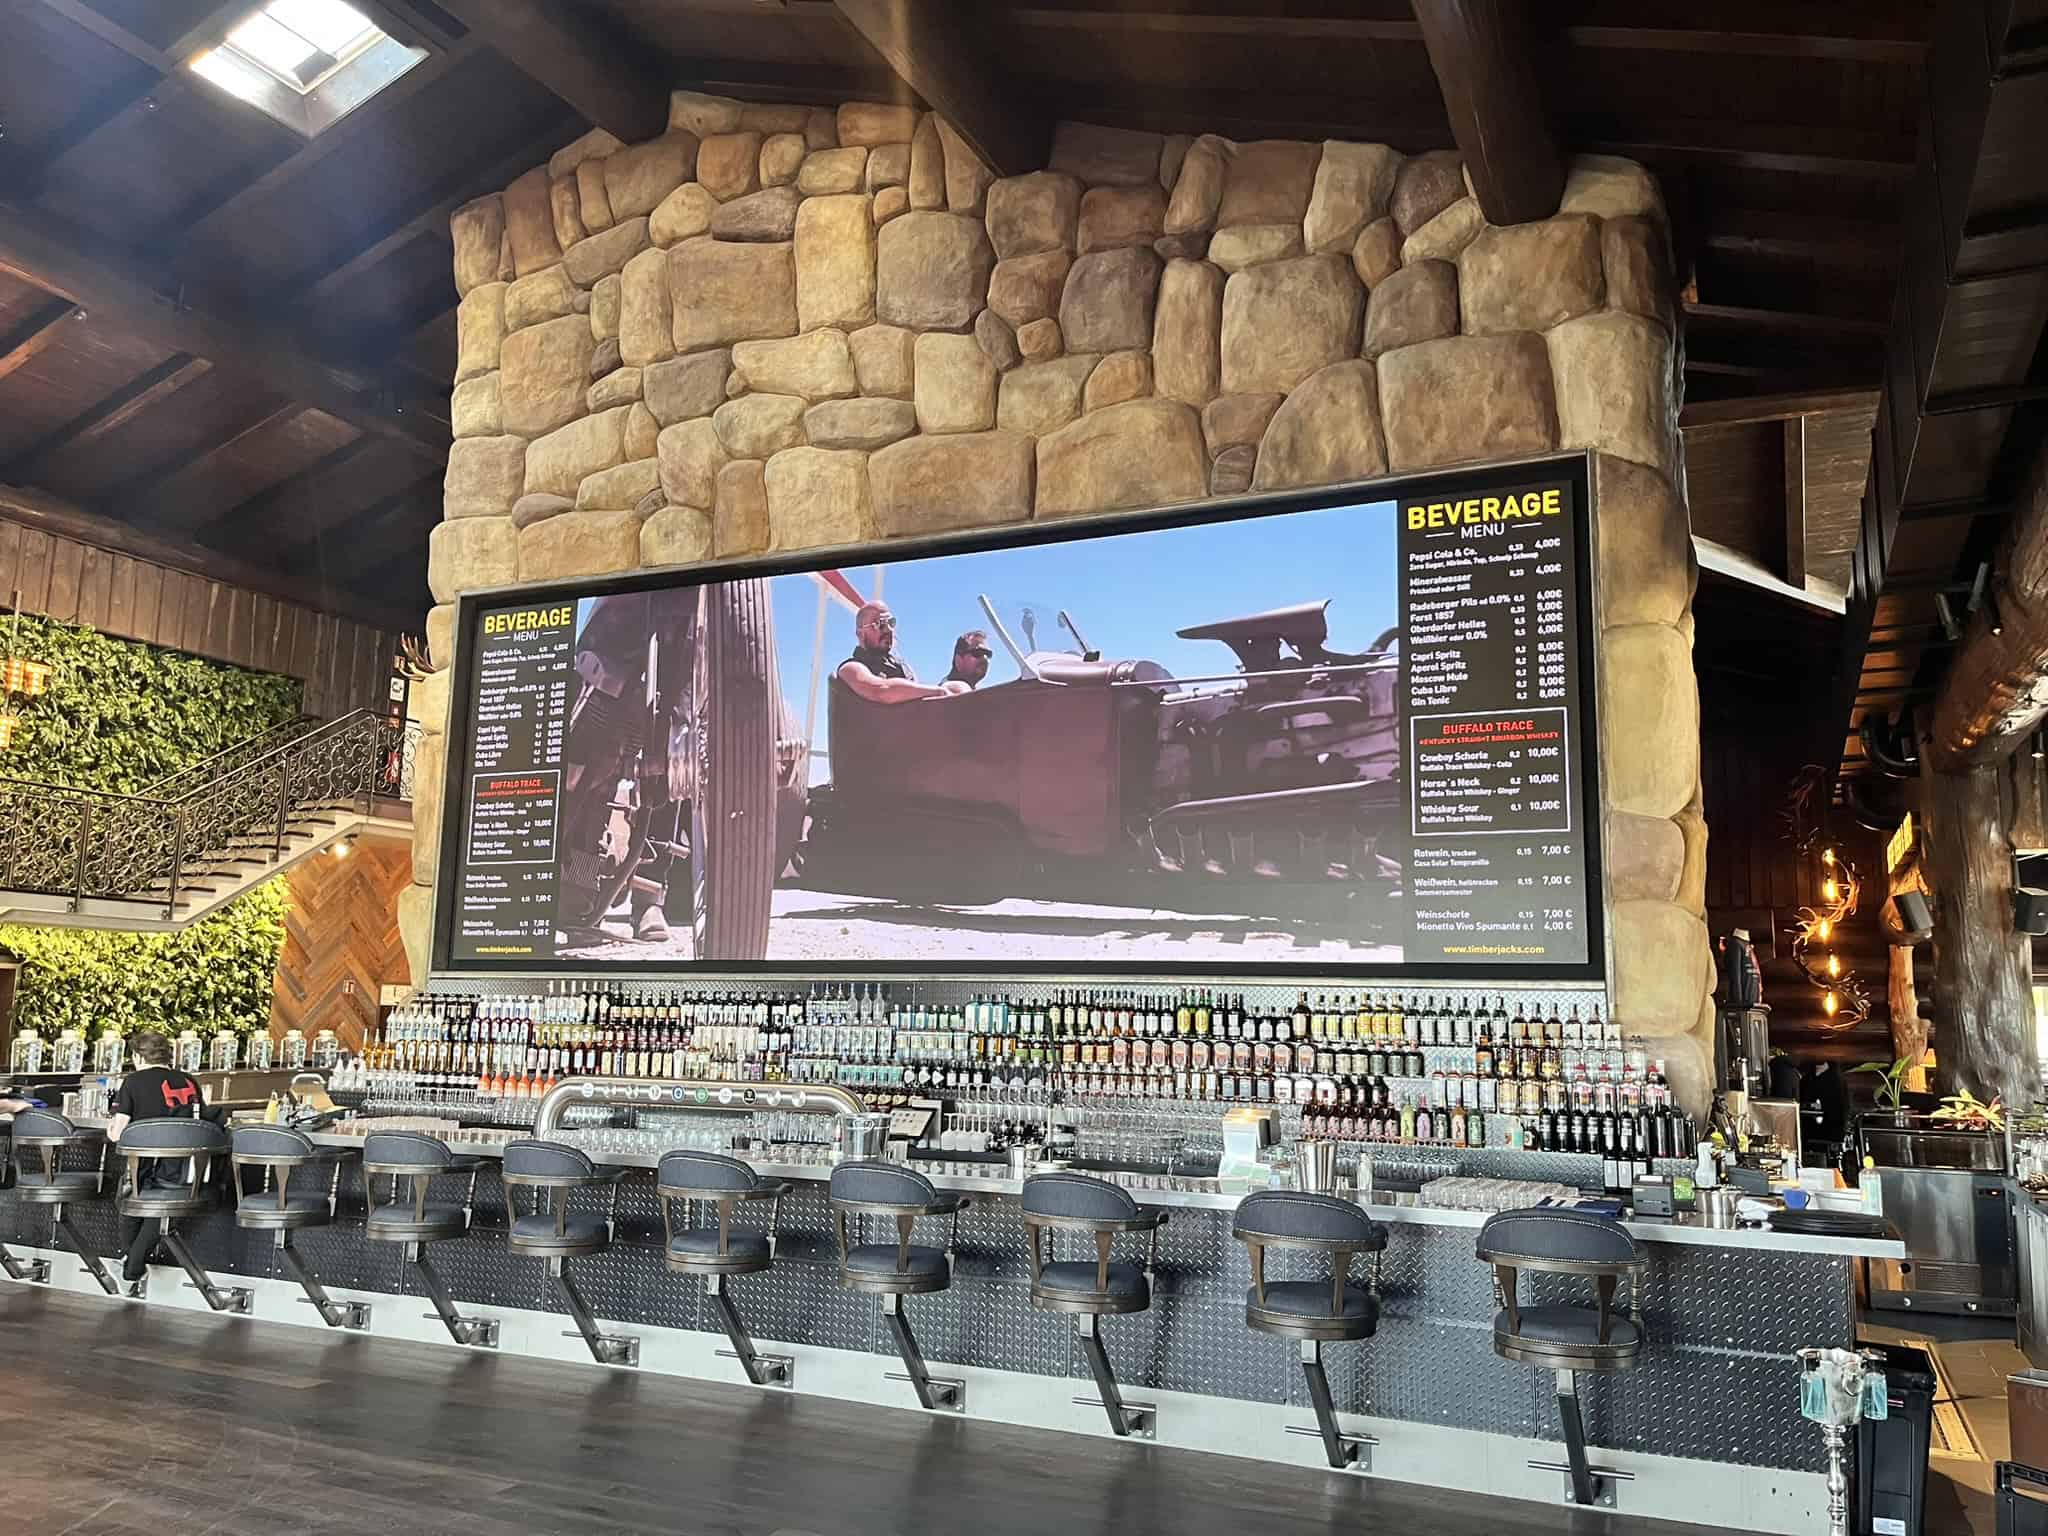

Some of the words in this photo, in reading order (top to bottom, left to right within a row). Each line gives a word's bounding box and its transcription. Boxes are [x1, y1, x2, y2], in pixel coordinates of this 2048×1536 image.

[1407, 490, 1560, 530] BEVERAGE
[1461, 522, 1505, 539] MENU
[1409, 551, 1432, 562] Pepsi
[1434, 549, 1453, 559] Cola
[1454, 548, 1462, 557] &
[1410, 600, 1459, 612] Radeberger
[1460, 598, 1478, 607] Pils
[484, 607, 571, 634] BEVERAGE
[513, 630, 539, 641] MENU
[1411, 651, 1434, 662] Capri
[1435, 649, 1461, 660] Spritz
[1411, 662, 1439, 673] Aperol
[1440, 661, 1467, 672] Spritz
[1411, 674, 1445, 684] Moscow
[1446, 672, 1468, 681] Mule
[1411, 686, 1433, 695] Cuba
[1434, 685, 1457, 694] Libre
[1411, 697, 1426, 706] Gin
[1443, 723, 1494, 735] BUFFALO
[1495, 720, 1534, 731] TRACE
[1420, 753, 1453, 763] Cowboy
[1527, 747, 1559, 758] 10,00€
[520, 779, 541, 788] TRACE
[1457, 777, 1480, 786] Neck
[1528, 774, 1560, 784] 10,00€
[1421, 804, 1457, 815] Whiskey
[1458, 804, 1480, 813] Sour
[1541, 846, 1561, 856] 7,00
[1563, 846, 1570, 854] €
[1542, 876, 1562, 886] 7,00
[1564, 876, 1571, 884] €
[1416, 910, 1470, 919] Weinschorle
[1543, 910, 1563, 919] 7,00
[1565, 910, 1573, 918] €
[1417, 923, 1455, 931] Mionetto
[1456, 923, 1474, 931] Vivo
[1476, 922, 1521, 932] Spumante
[1565, 922, 1573, 930] €
[1443, 945, 1545, 955] www.timberjacks.com
